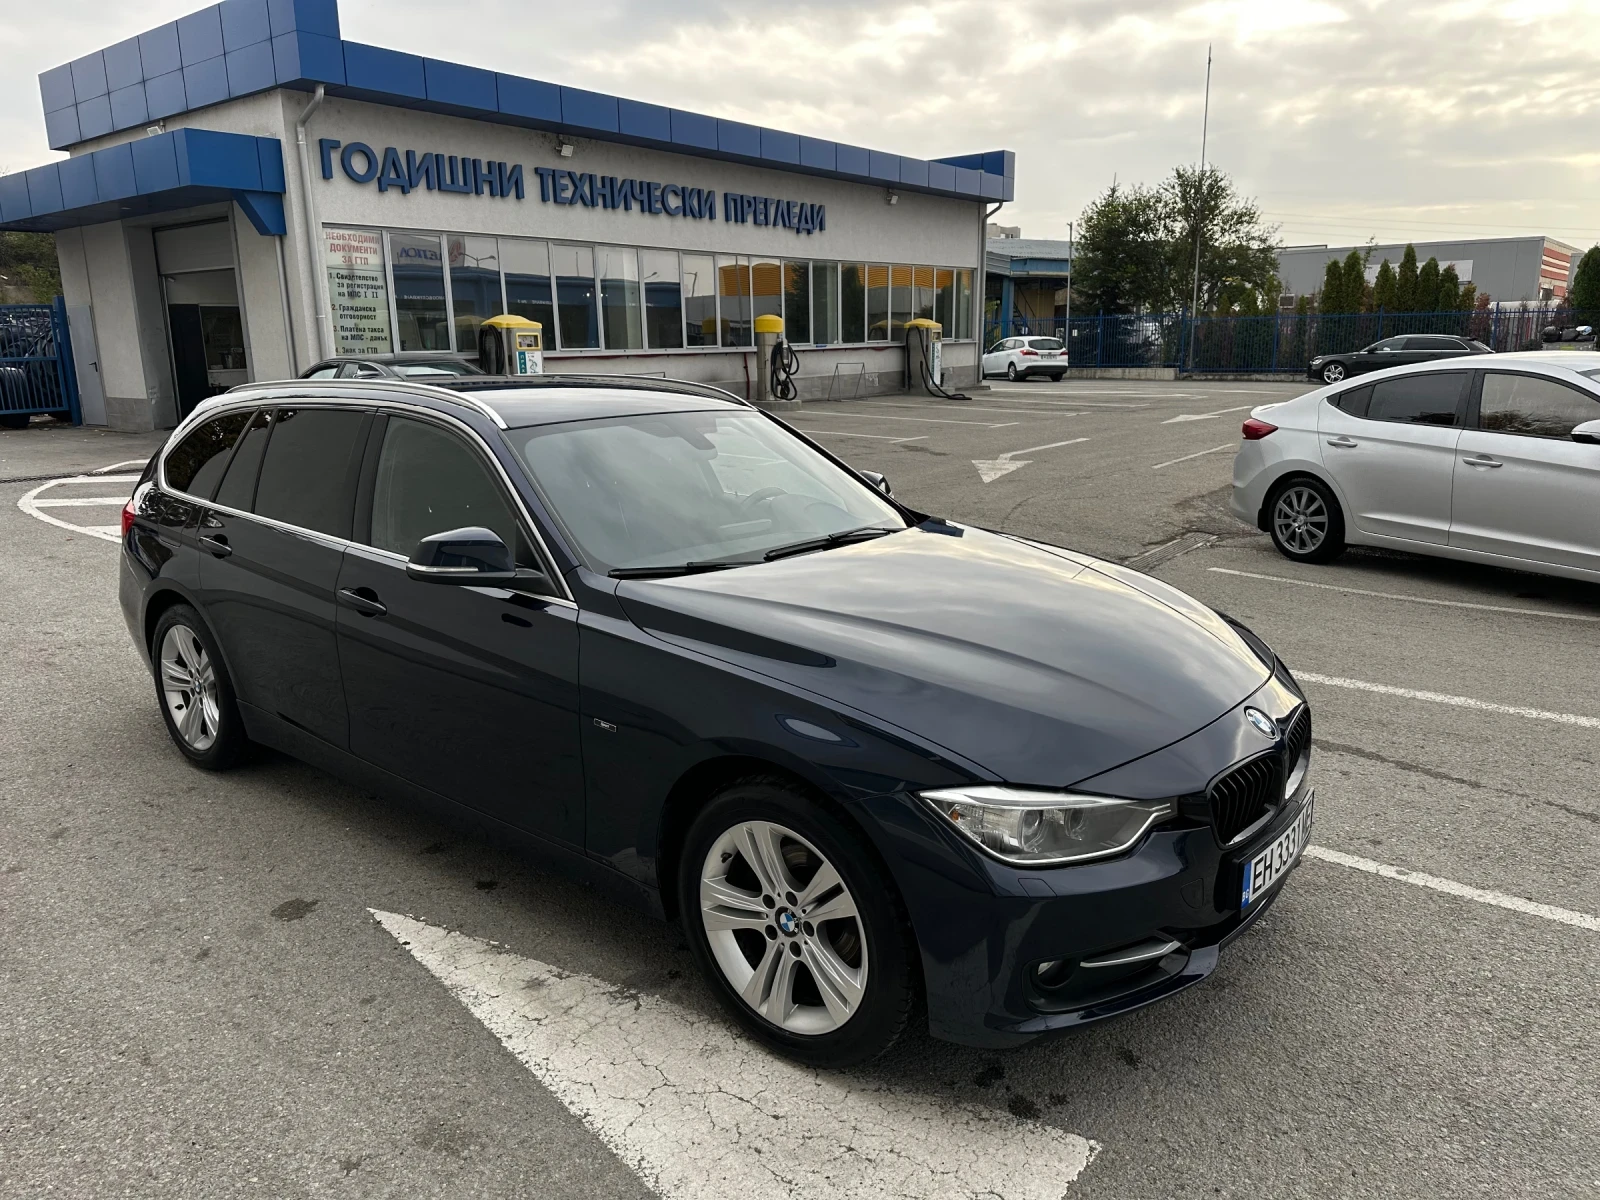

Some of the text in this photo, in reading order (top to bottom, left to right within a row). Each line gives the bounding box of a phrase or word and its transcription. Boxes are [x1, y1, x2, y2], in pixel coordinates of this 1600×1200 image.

[318, 137, 826, 235] ГОДИШНИ ТЕХНИЧЕСКИ ПРЕГЛЕДИ
[325, 231, 380, 245] НЕОБХОДИМИ
[330, 243, 377, 255] ДОКУМЕНТИ
[341, 255, 369, 265] ЗА ГТП
[346, 282, 384, 291] регистрация
[346, 290, 362, 298] МПС
[338, 303, 377, 313] Гражданска
[339, 313, 377, 321] отговорност
[340, 325, 366, 333] Платена
